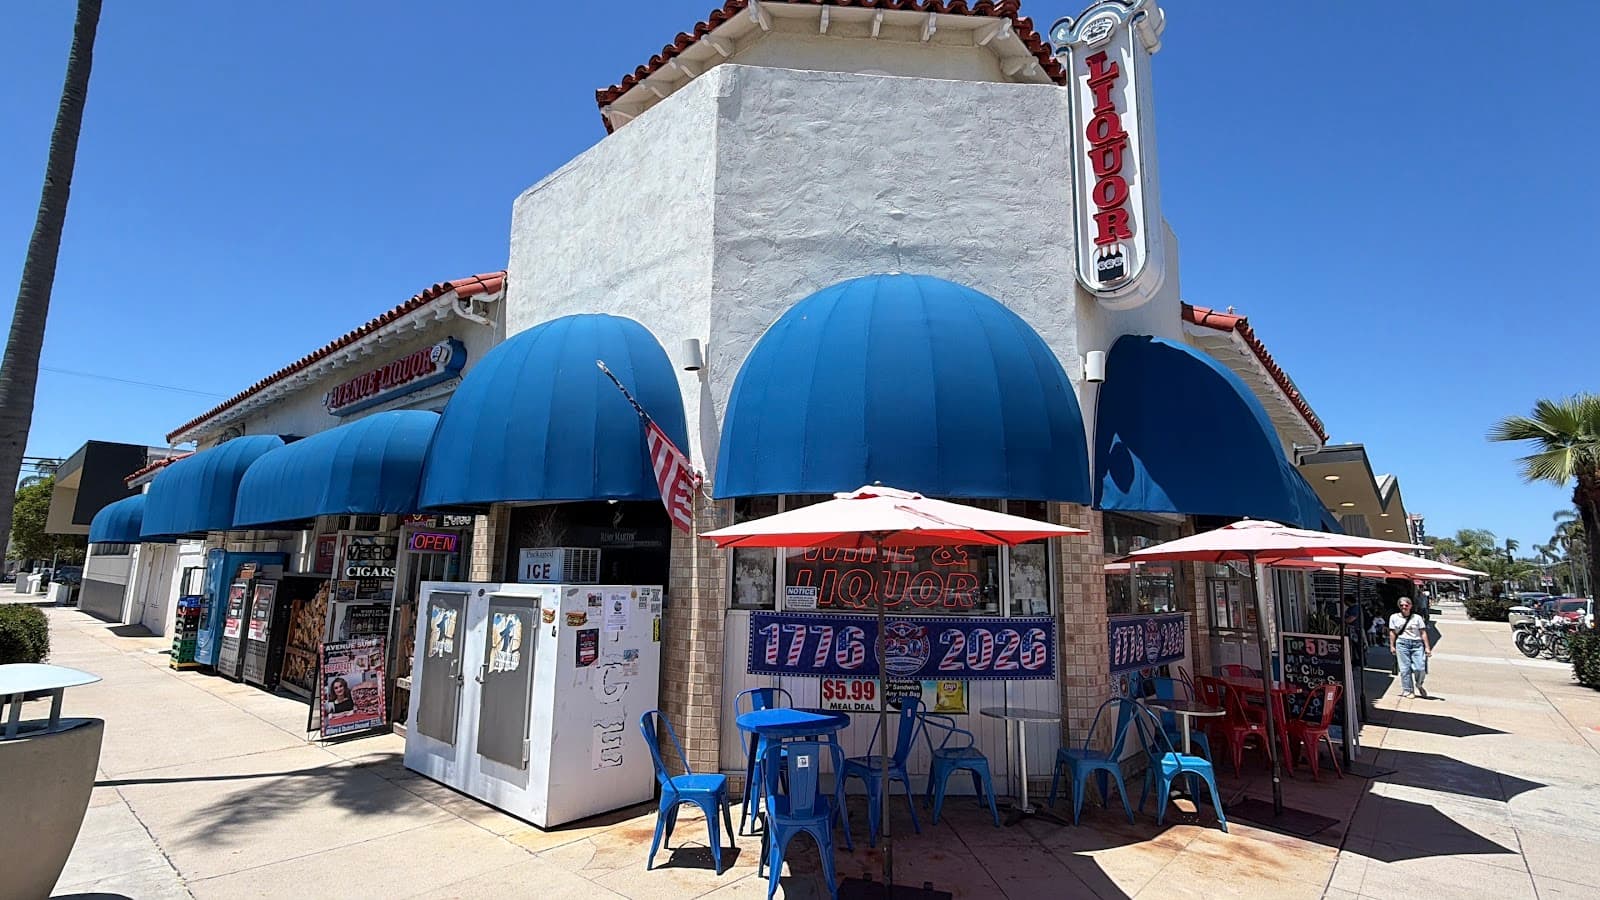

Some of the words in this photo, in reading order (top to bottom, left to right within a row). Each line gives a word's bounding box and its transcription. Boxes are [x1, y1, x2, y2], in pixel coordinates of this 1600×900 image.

[1085, 50, 1133, 245] LIQUOR
[331, 370, 377, 408] AVENUE
[378, 349, 435, 390] LIQUOR
[414, 534, 455, 550] OPEN
[526, 550, 554, 558] Packaged
[346, 566, 397, 577] CIGARS
[526, 563, 551, 579] ICE
[325, 643, 356, 651] AVENUE
[758, 622, 866, 669] 1776
[938, 627, 1047, 671] 2026
[1112, 624, 1144, 665] 1776
[1305, 638, 1316, 655] 5
[823, 678, 875, 701] $5.99
[908, 690, 921, 698] Bag
[829, 702, 851, 710] MEAL
[854, 702, 875, 711] DEAL
